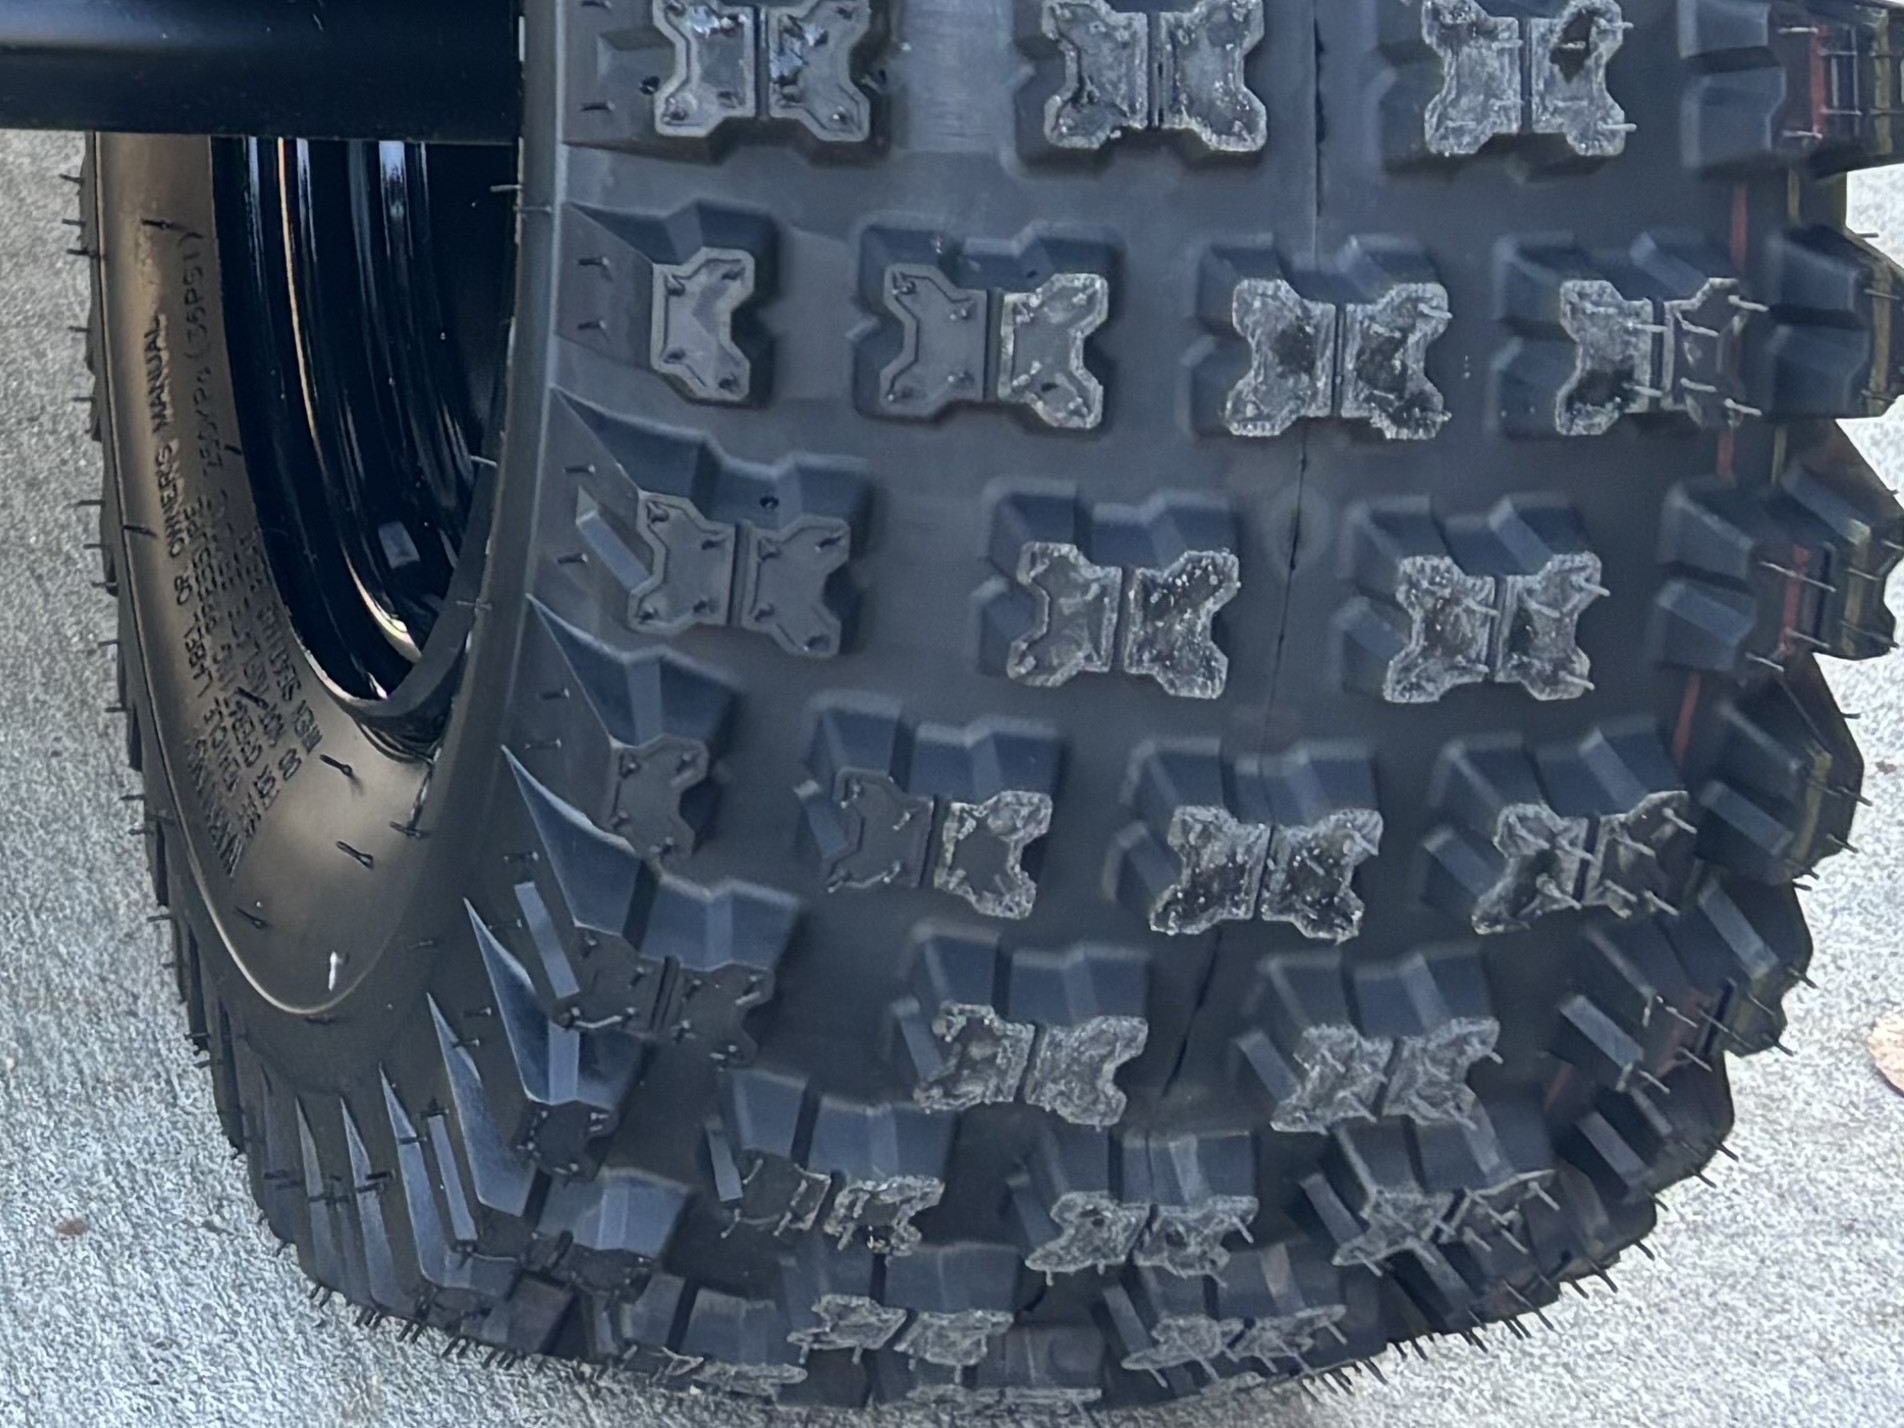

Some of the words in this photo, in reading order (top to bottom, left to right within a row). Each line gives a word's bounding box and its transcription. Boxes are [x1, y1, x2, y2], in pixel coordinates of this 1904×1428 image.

[143, 314, 174, 433] MANUAL
[153, 440, 189, 559] OWNER'S
[173, 574, 192, 606] OR
[183, 611, 213, 697] LABEL
